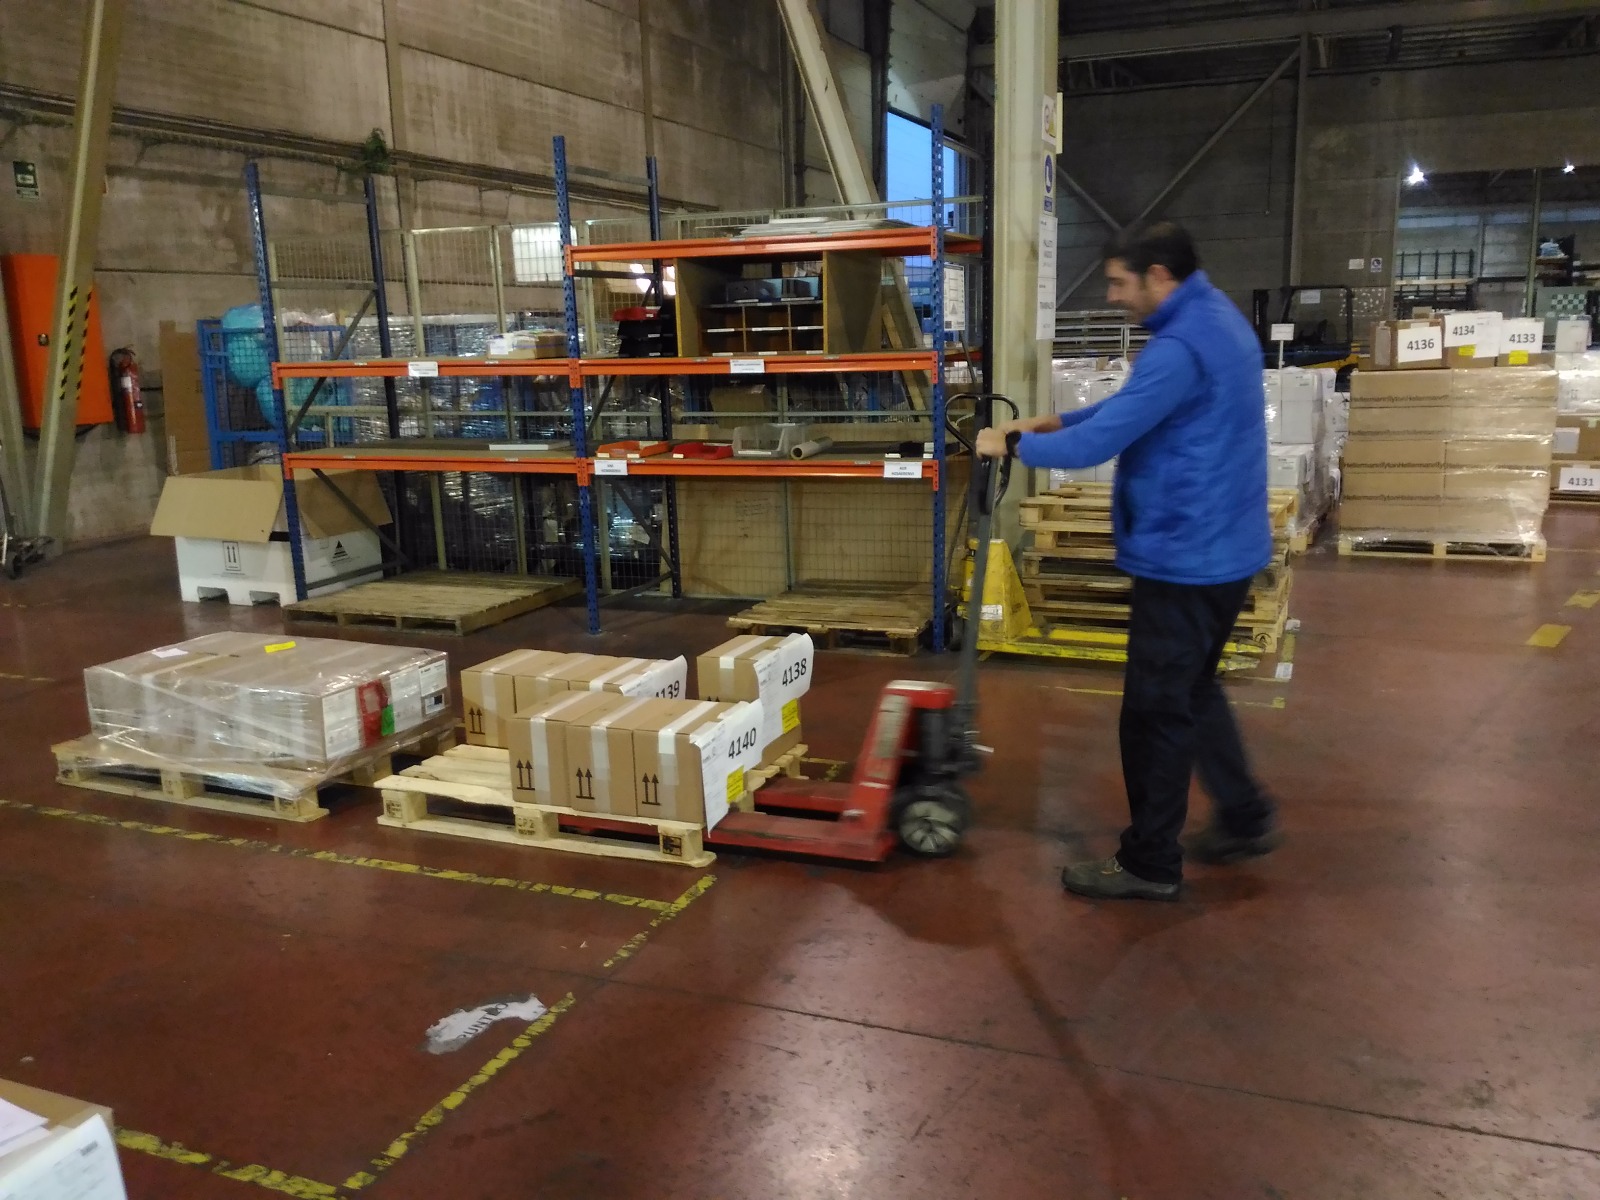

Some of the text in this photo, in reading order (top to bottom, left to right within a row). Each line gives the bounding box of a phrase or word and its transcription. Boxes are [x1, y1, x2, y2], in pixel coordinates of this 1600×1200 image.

[1452, 325, 1475, 336] 4134
[1407, 338, 1435, 351] 4136
[1509, 333, 1536, 344] 4133
[1568, 477, 1594, 487] 4131
[781, 657, 807, 687] 4138
[728, 727, 757, 760] 4140
